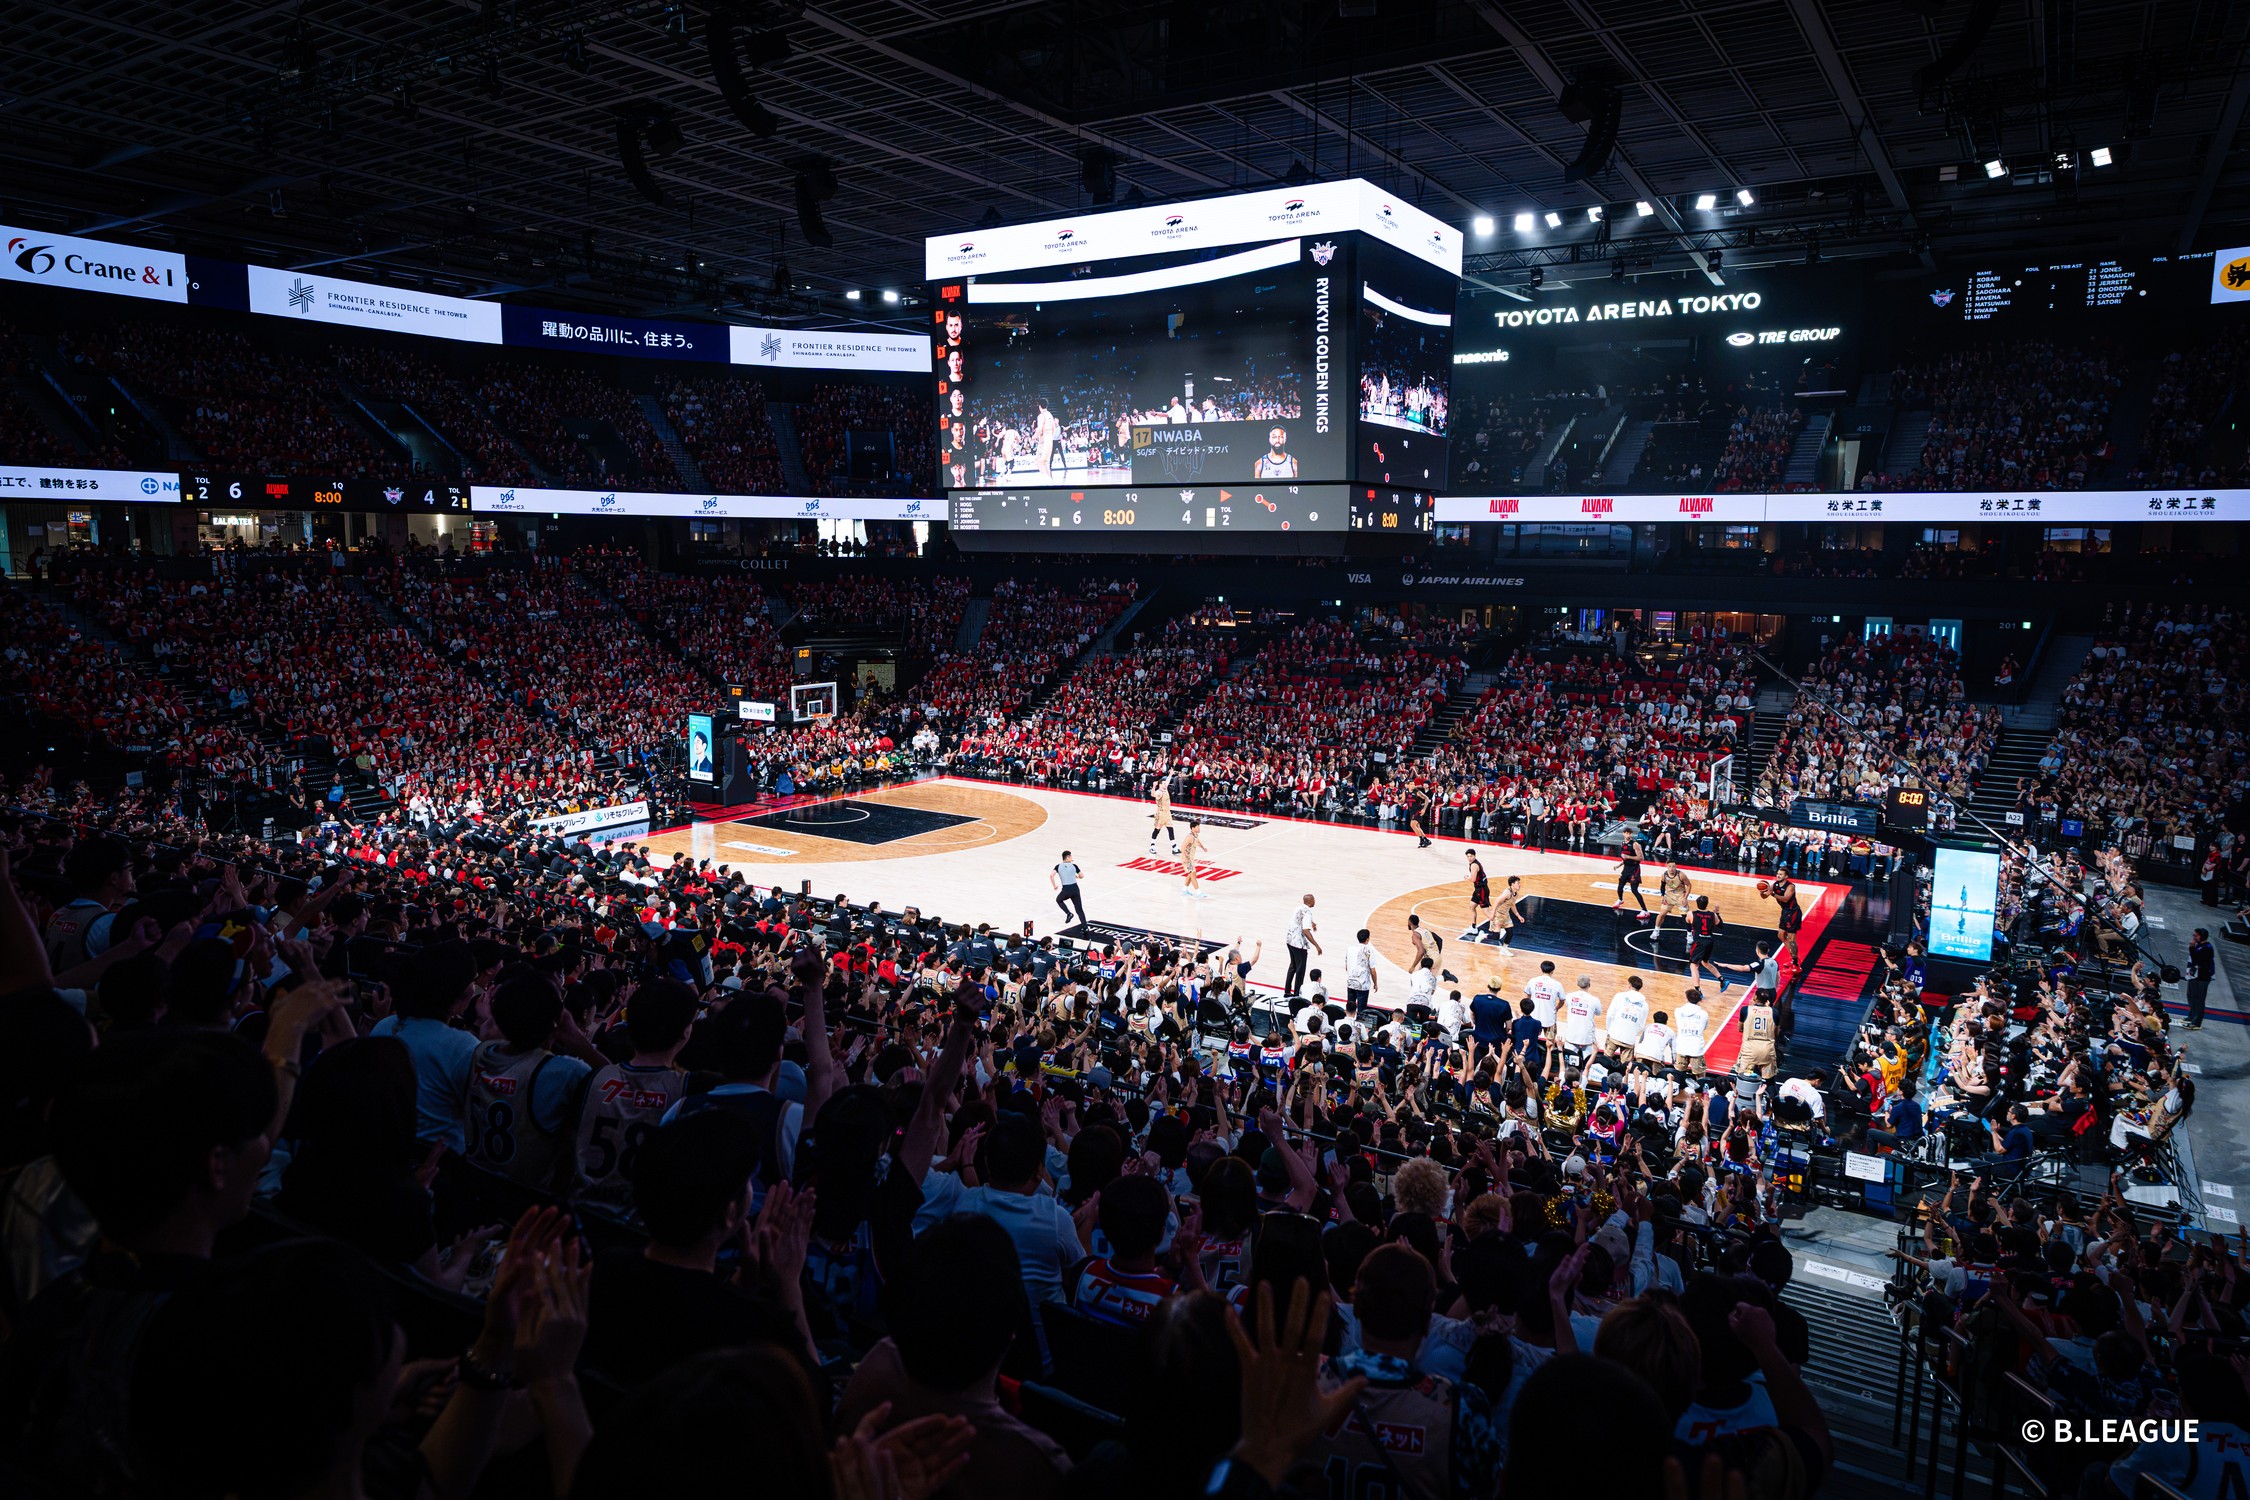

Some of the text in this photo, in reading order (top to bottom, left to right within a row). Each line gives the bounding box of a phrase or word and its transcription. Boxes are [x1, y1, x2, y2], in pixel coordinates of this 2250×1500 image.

[1268, 210, 1320, 222] TOYOTA ARENA
[1150, 226, 1198, 236] TOYOTA ARENA
[1044, 242, 1066, 250] TOYOTA
[948, 252, 986, 262] TOYOTA ARENA
[64, 254, 136, 282] Crane
[142, 266, 160, 285] &
[166, 268, 173, 286] I
[2100, 266, 2122, 274] JONES
[2100, 272, 2135, 280] YAMAUCHI
[942, 286, 960, 298] ALVARK
[328, 292, 376, 306] FRONTIER
[380, 300, 430, 314] RESIDENCE
[447, 310, 468, 319] TOWER
[328, 303, 364, 312] SHINAGAWA
[1494, 292, 1761, 328] TOYOTA ARENA TOKYO
[542, 320, 694, 350] 躍動の品川に、住まう。
[1758, 327, 1840, 344] TRE GROUP
[792, 342, 832, 350] FRONTIER
[836, 344, 882, 352] RESIDENCE
[1316, 277, 1329, 434] RYUKYU GOLDEN KINGS
[1136, 429, 1202, 443] 17 NWABA
[1136, 448, 1156, 457] SG/SF
[229, 482, 242, 499] 6
[332, 482, 344, 490] 1Q
[1289, 486, 1298, 494] 1Q
[198, 486, 208, 499] 2
[314, 492, 342, 504] 8:00
[424, 490, 434, 504] 4
[1126, 494, 1138, 502] 1Q
[451, 496, 458, 507] 2
[1490, 500, 1519, 512] ALVARK
[1582, 499, 1614, 512] ALVARK
[1679, 498, 1714, 512] ALVARK
[1826, 500, 1883, 512] 松栄工業
[1980, 498, 2042, 511] 松栄工業
[2148, 496, 2216, 510] 松栄工業
[1040, 516, 1046, 526] 2
[1072, 510, 1082, 524] 6
[1104, 510, 1135, 525] 8:00
[1182, 510, 1192, 524] 4
[1222, 515, 1230, 526] 2
[1352, 515, 1356, 526] 2
[1368, 512, 1373, 526] 6
[1382, 512, 1398, 528] 8:00
[1414, 515, 1419, 528] 4
[740, 559, 790, 570] COLLET
[1347, 574, 1372, 584] VISA
[1418, 576, 1524, 586] JAPAN AIRLINES
[1898, 791, 1924, 806] 8:00
[603, 806, 644, 821] りそなグループ
[1808, 812, 1858, 826] Brillia
[2008, 814, 2022, 822] A22
[1940, 932, 1981, 945] Brillia
[1910, 974, 1922, 984] 013
[1754, 1016, 1766, 1030] 21
